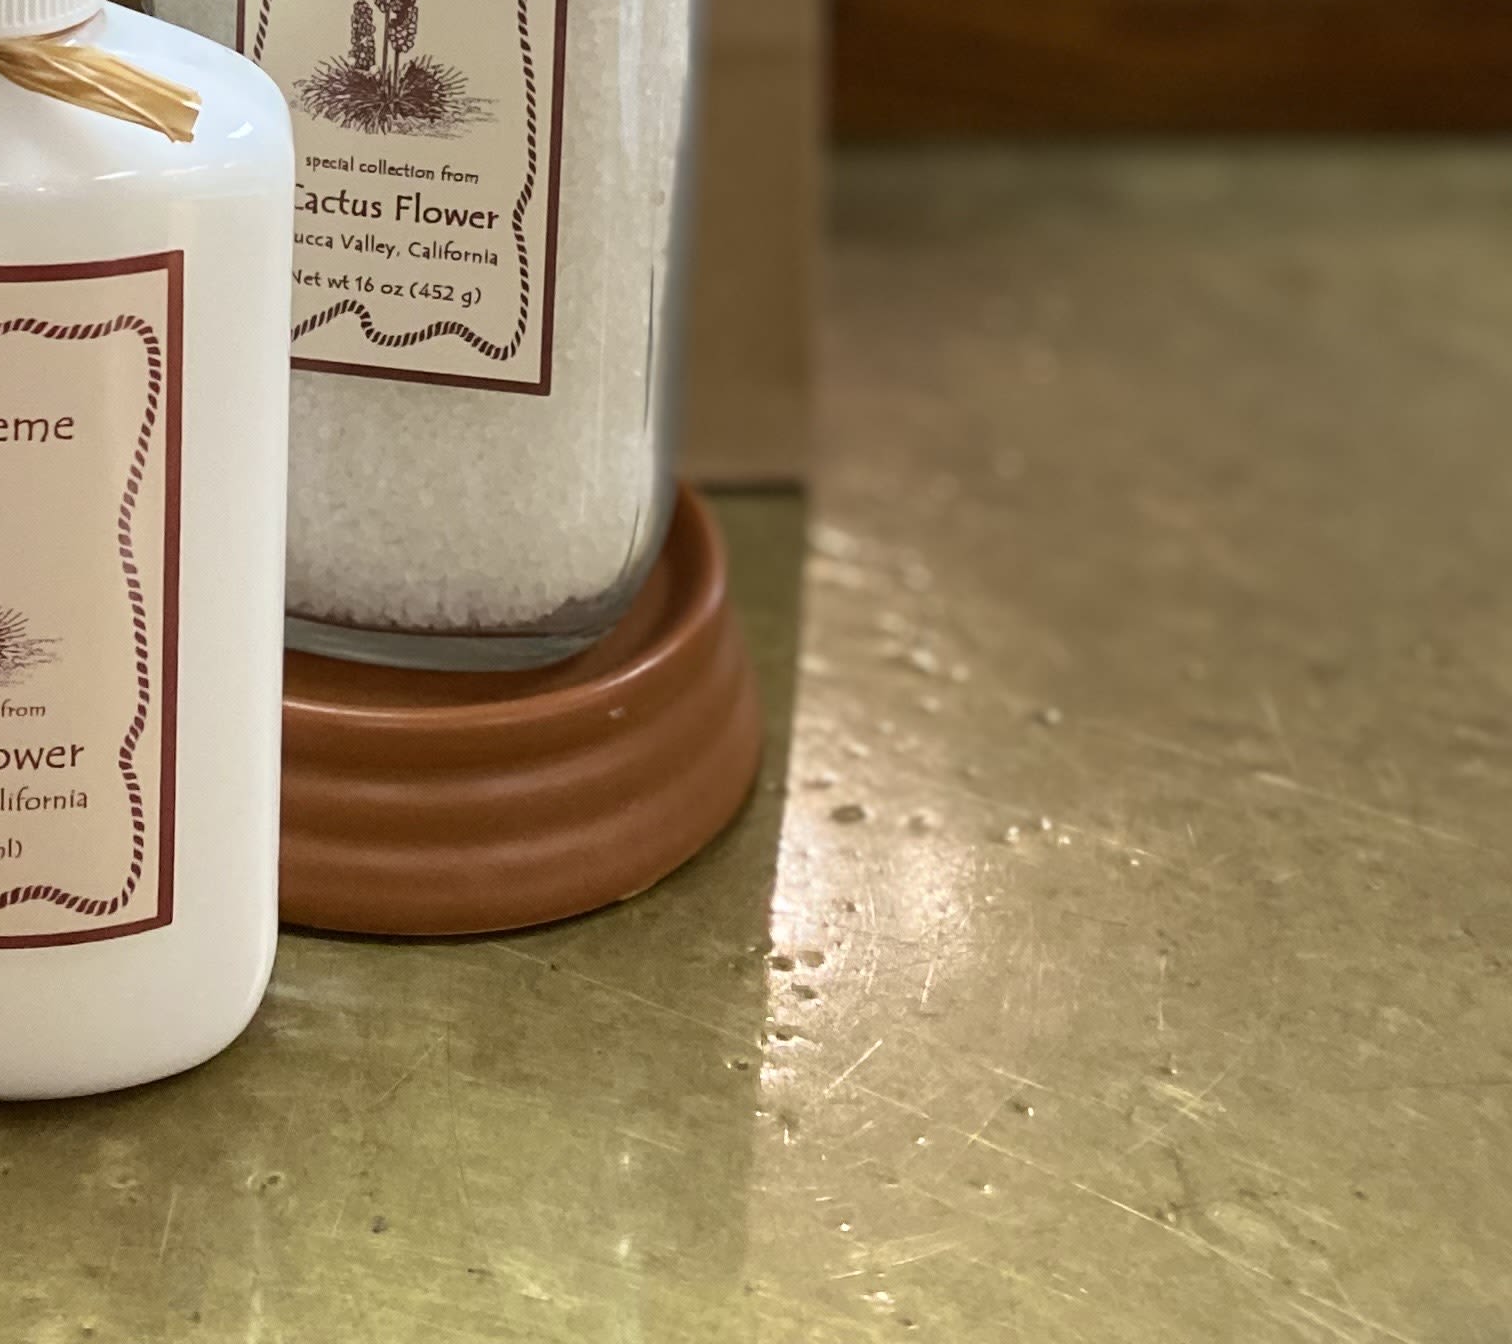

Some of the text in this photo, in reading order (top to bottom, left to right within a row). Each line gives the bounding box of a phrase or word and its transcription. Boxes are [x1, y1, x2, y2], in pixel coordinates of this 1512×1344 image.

[305, 156, 479, 185] special collection from
[395, 192, 500, 230] Flower
[294, 233, 498, 266] ucca Valley, California
[327, 275, 350, 290] wt
[355, 277, 375, 293] 16
[381, 284, 404, 297] oz
[409, 281, 454, 302] (452
[461, 287, 482, 308] g)
[1, 699, 46, 718] from
